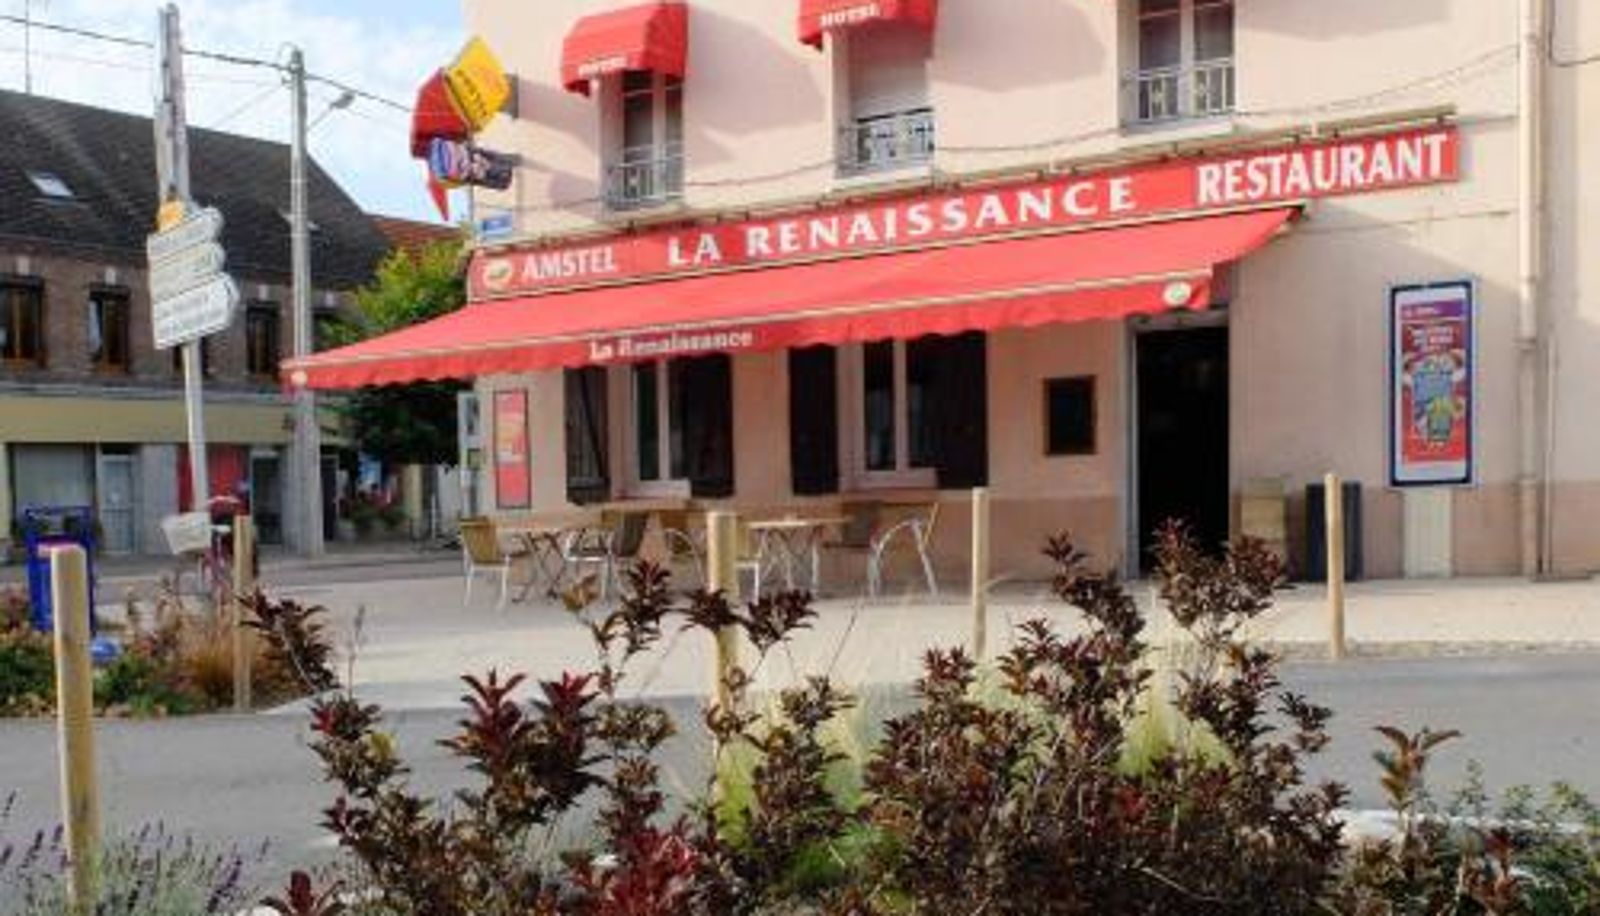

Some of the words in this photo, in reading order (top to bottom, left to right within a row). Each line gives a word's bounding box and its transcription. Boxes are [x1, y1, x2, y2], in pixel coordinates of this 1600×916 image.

[1197, 133, 1448, 205] RESTAURANT
[668, 234, 721, 267] LA
[746, 177, 1136, 258] RENAISSANCE
[523, 246, 616, 279] AMSTEL
[589, 340, 613, 361] La
[618, 330, 753, 357] Renaissance
